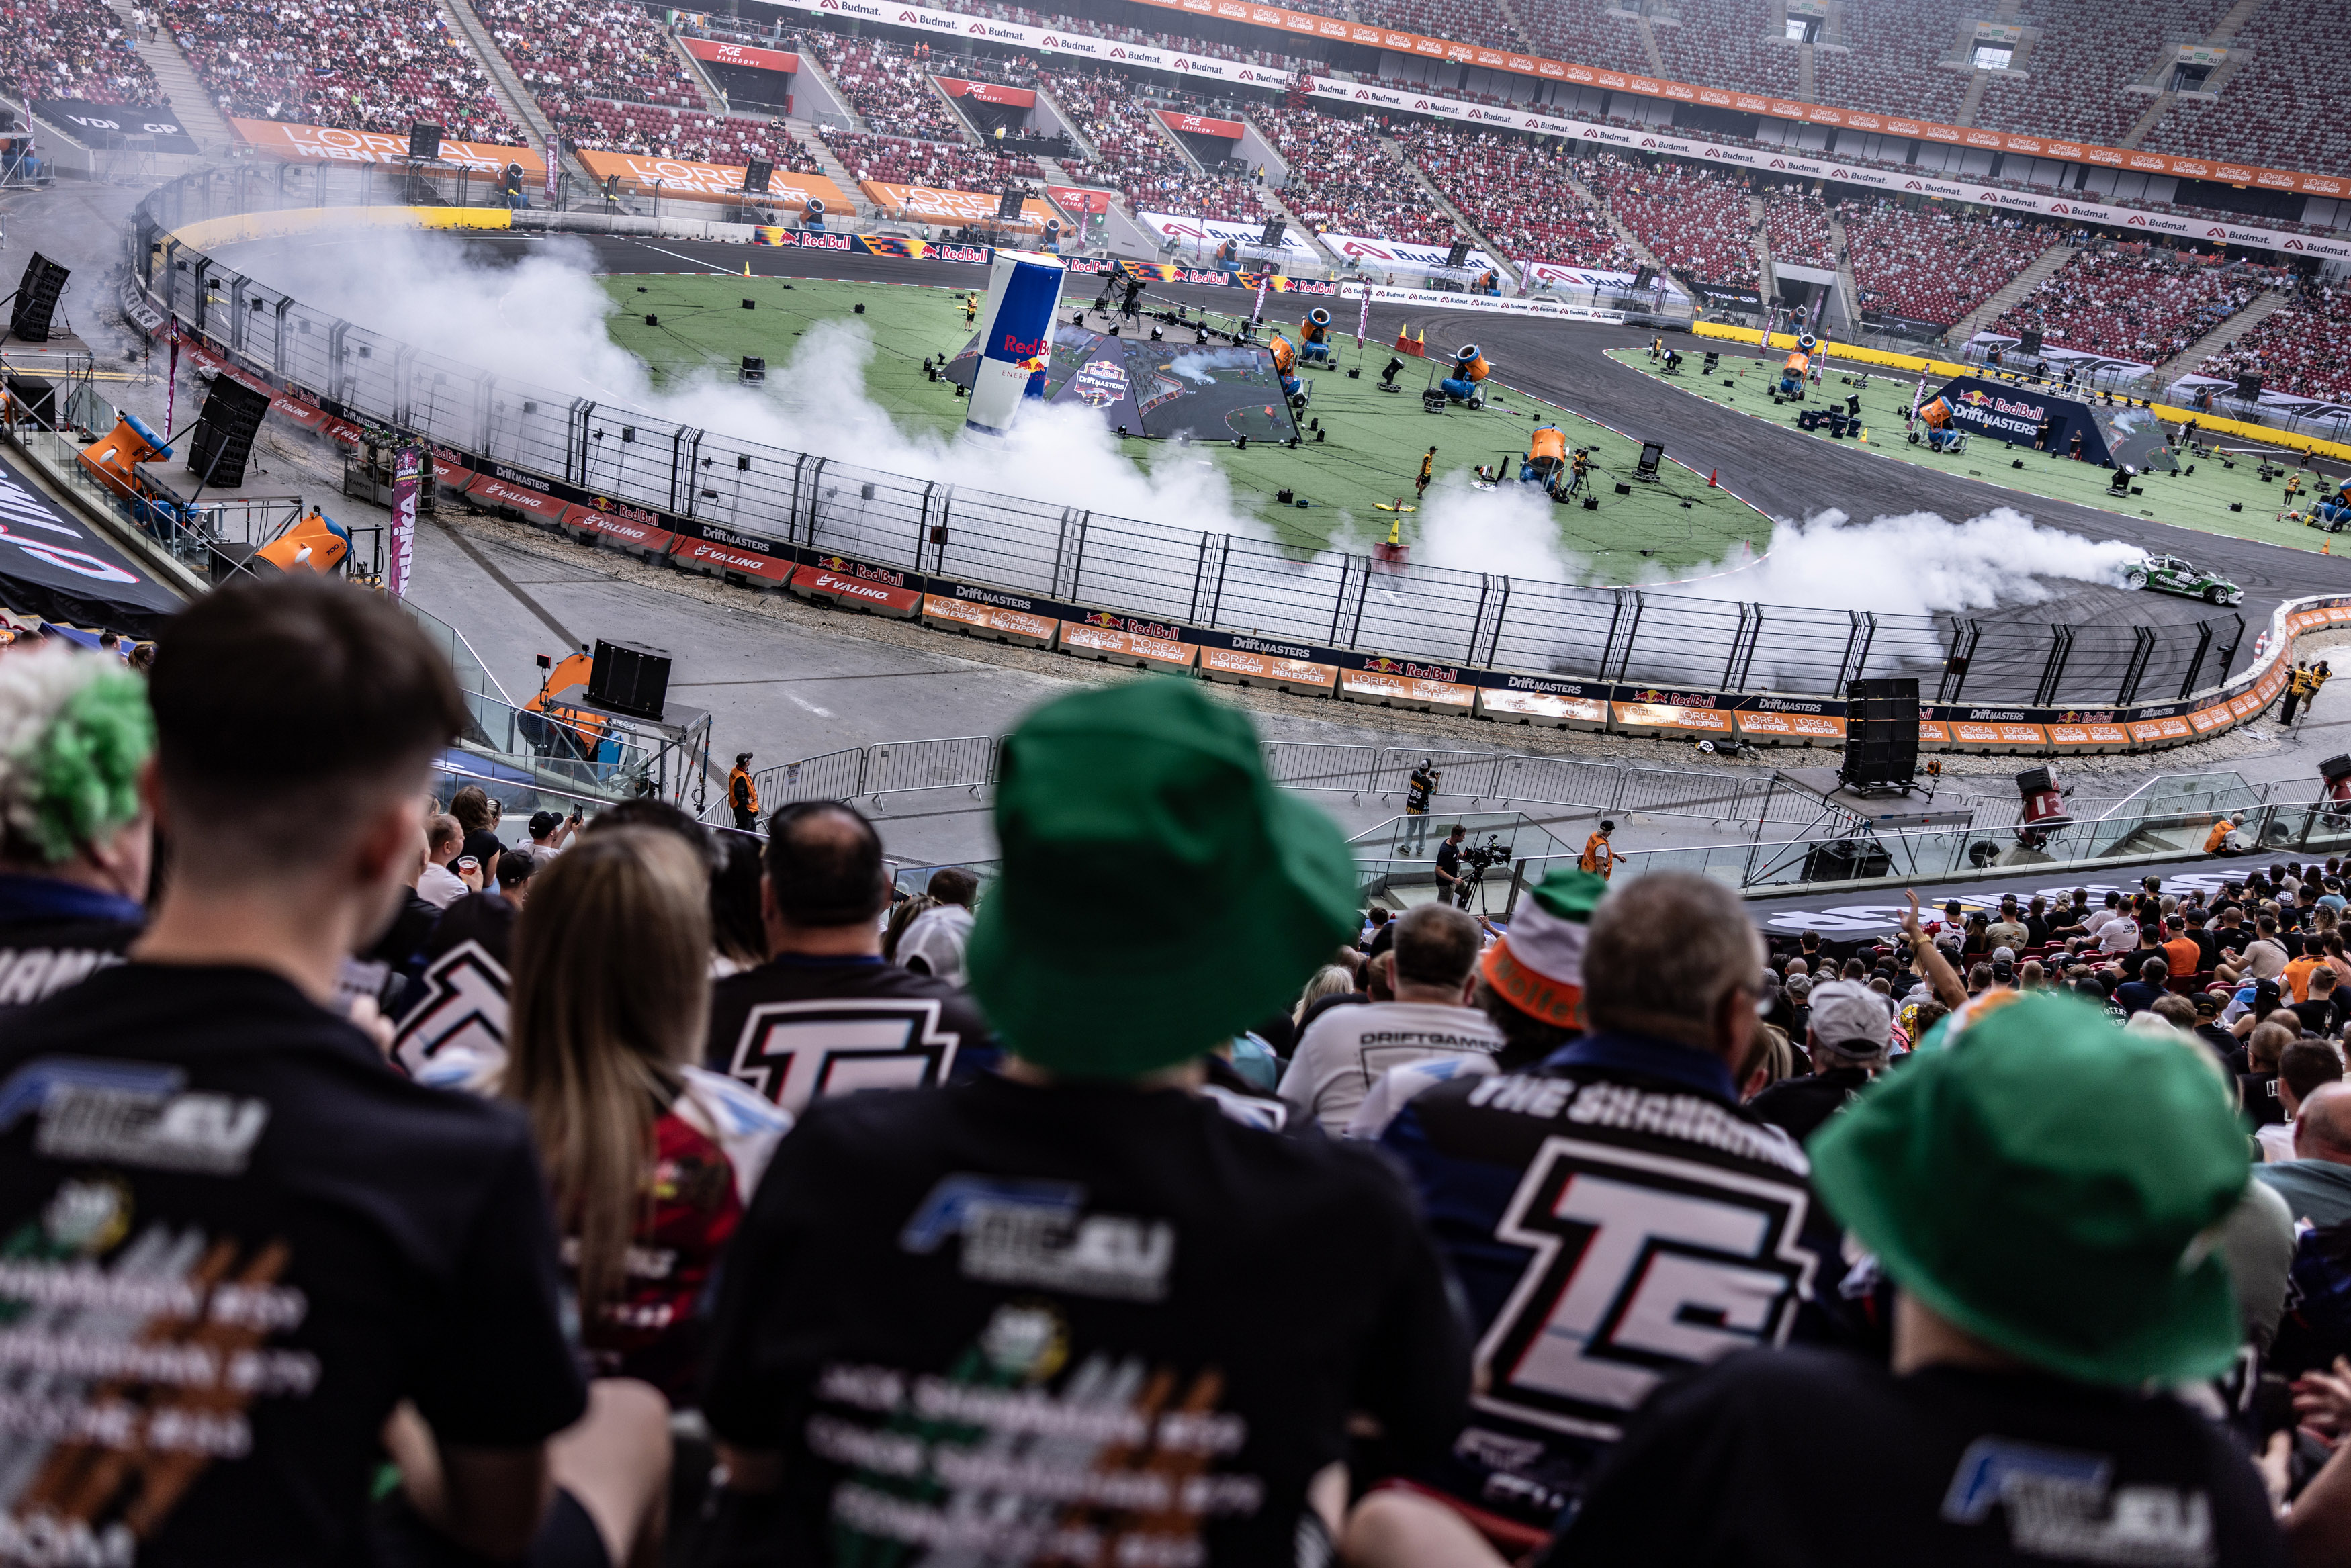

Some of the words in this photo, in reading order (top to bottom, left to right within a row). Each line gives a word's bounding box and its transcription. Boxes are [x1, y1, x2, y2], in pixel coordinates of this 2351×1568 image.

[717, 45, 742, 56] PGE
[716, 54, 760, 66] NARODOWY
[967, 83, 987, 94] PGE
[966, 93, 1002, 102] RODOWY
[1182, 116, 1201, 126] PGE
[144, 123, 178, 134] GP
[1180, 125, 1214, 134] NARODOWY
[294, 143, 376, 162] MEN
[639, 175, 705, 193] MEN
[1063, 192, 1081, 201] PGE
[1038, 340, 1051, 355] Bu
[1002, 370, 1033, 380] ENERGY
[498, 486, 541, 507] VALINO
[603, 519, 645, 540] VALINO
[325, 544, 339, 556] 700
[710, 551, 764, 570] VALINO
[832, 581, 889, 600] VALINO
[932, 599, 983, 616] L'ORÉAL
[930, 607, 950, 617] MEN
[950, 609, 983, 623] EXPERT
[1089, 637, 1124, 649] EXPERT
[1133, 638, 1185, 655] L'ORÉAL
[1130, 646, 1151, 655] MEN
[1151, 649, 1185, 661] EXPERT
[1211, 651, 1263, 667] L'ORÉAL
[1210, 660, 1230, 670] MEN
[1230, 662, 1263, 673] EXPERT
[1272, 661, 1325, 677] L'ORÉAL
[1272, 670, 1292, 678] MEN
[1292, 672, 1325, 683] EXPERT
[1352, 674, 1404, 689] L'ORÉAL
[1677, 707, 1724, 723] L'ORÉAL
[1744, 714, 1789, 725] L'ORÉAL
[1679, 719, 1697, 727] MEN
[1697, 719, 1724, 729] EXPERT
[1793, 718, 1838, 729] L'ORÉAL
[1958, 725, 1997, 734] L'ORÉAL
[1813, 727, 1838, 735] EXPERT
[2052, 727, 2086, 736] L'ORÉAL
[1360, 1031, 1503, 1052] DRIFTGAMES
